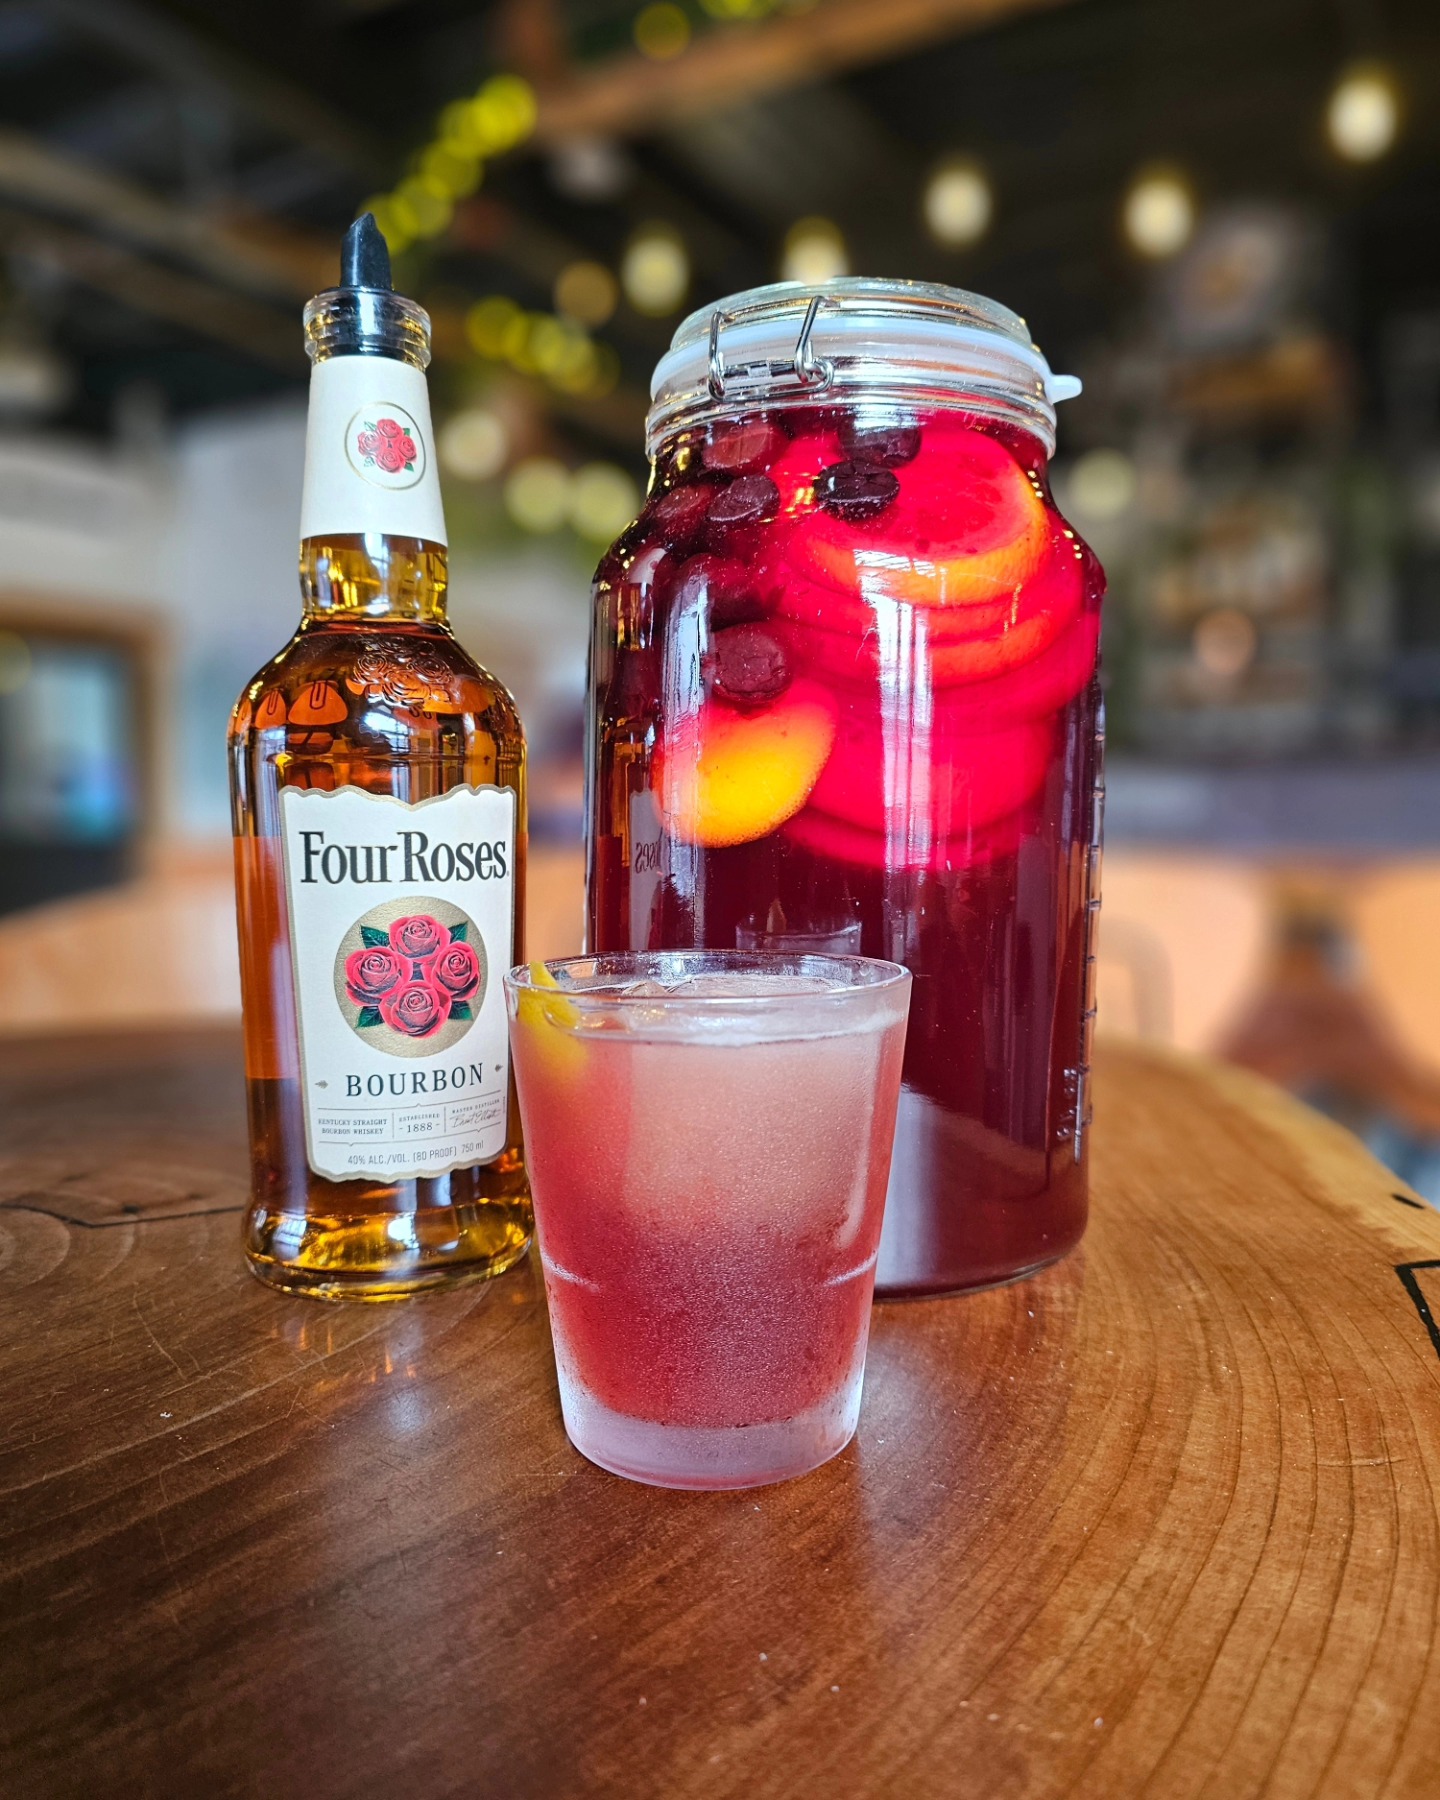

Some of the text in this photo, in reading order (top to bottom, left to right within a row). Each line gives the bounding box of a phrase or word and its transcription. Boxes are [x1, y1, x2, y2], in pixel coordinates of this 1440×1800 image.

[299, 831, 507, 884] Four Roses
[346, 1062, 483, 1097] BOURBON
[318, 1118, 351, 1126] KENTUCKY
[407, 1122, 433, 1133] 1888
[347, 1155, 367, 1165] 40%
[461, 1142, 474, 1154] 750
